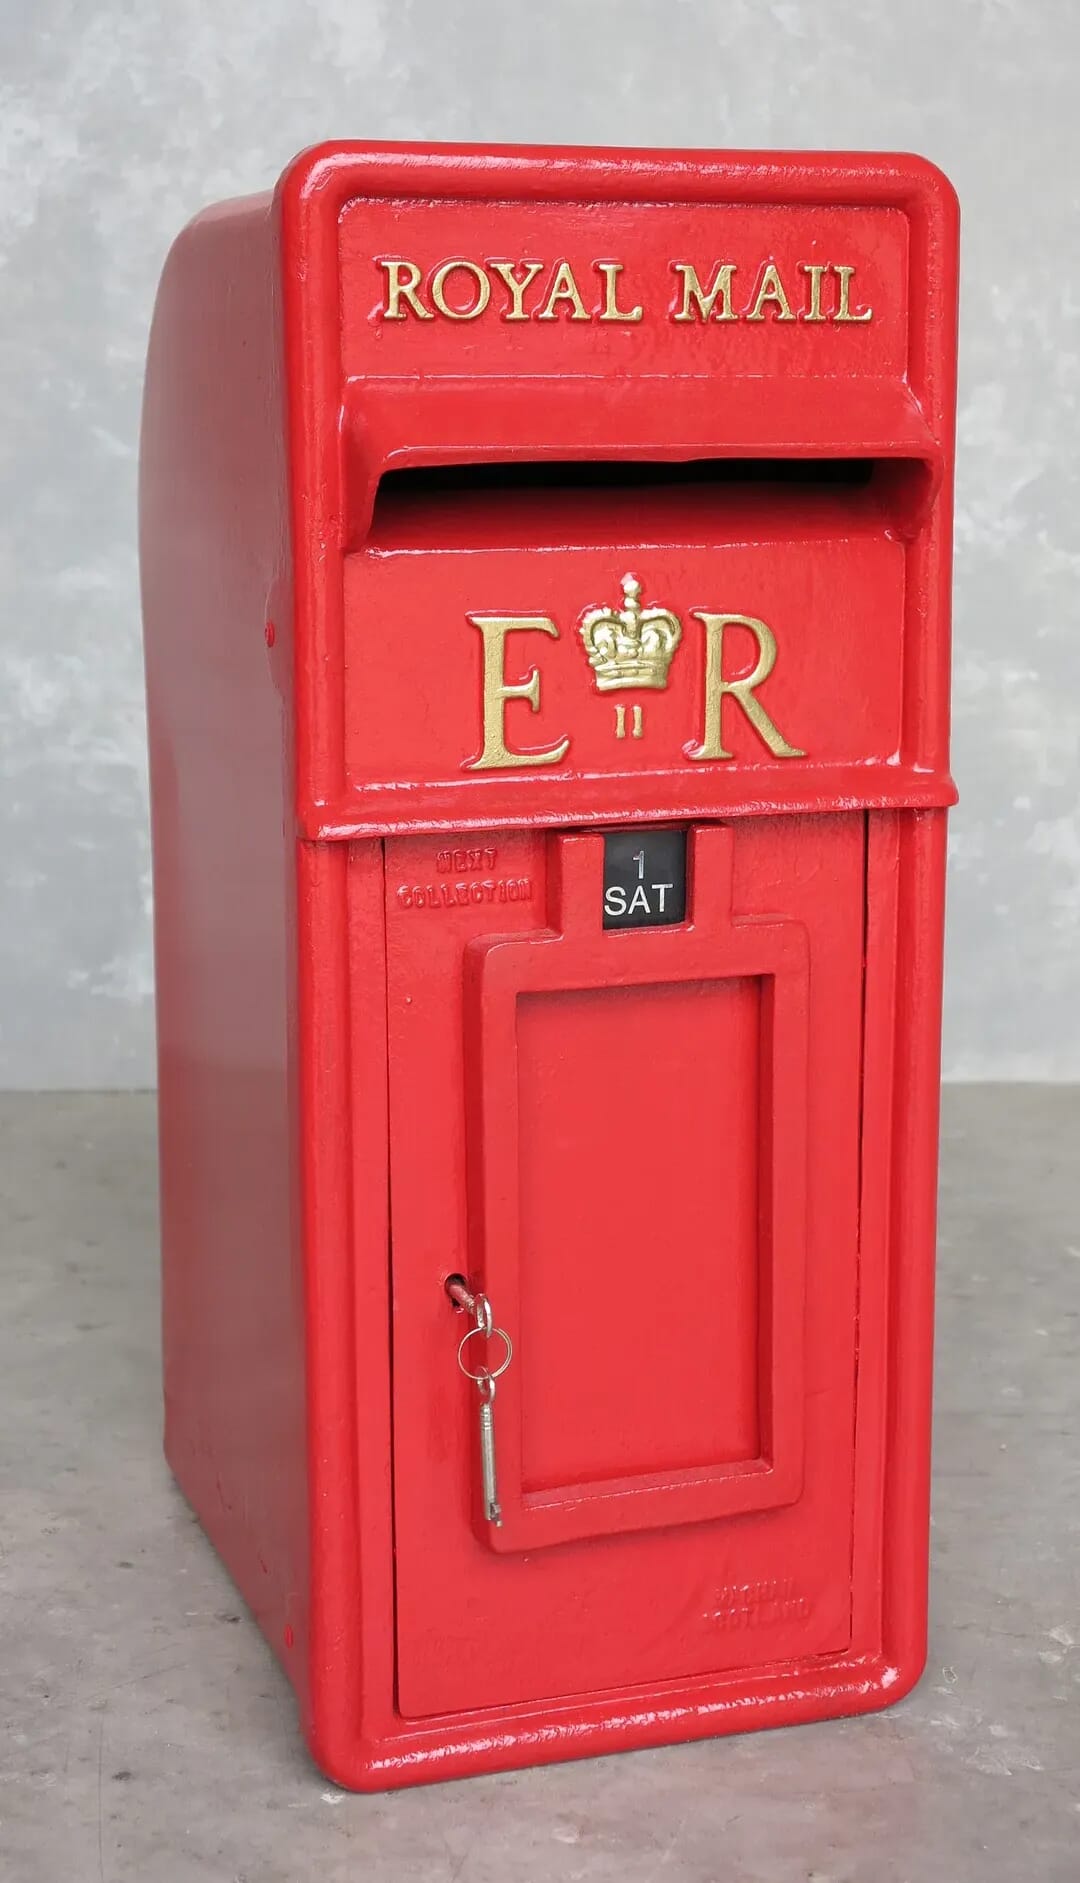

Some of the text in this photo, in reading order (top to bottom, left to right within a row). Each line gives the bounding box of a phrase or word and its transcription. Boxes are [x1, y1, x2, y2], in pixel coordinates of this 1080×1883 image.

[379, 260, 873, 323] ROYAL MAIL
[466, 611, 808, 771] E R
[435, 847, 498, 875] NEXT
[631, 850, 646, 880] 1
[396, 877, 534, 909] COLLECTION
[603, 883, 675, 917] SAT
